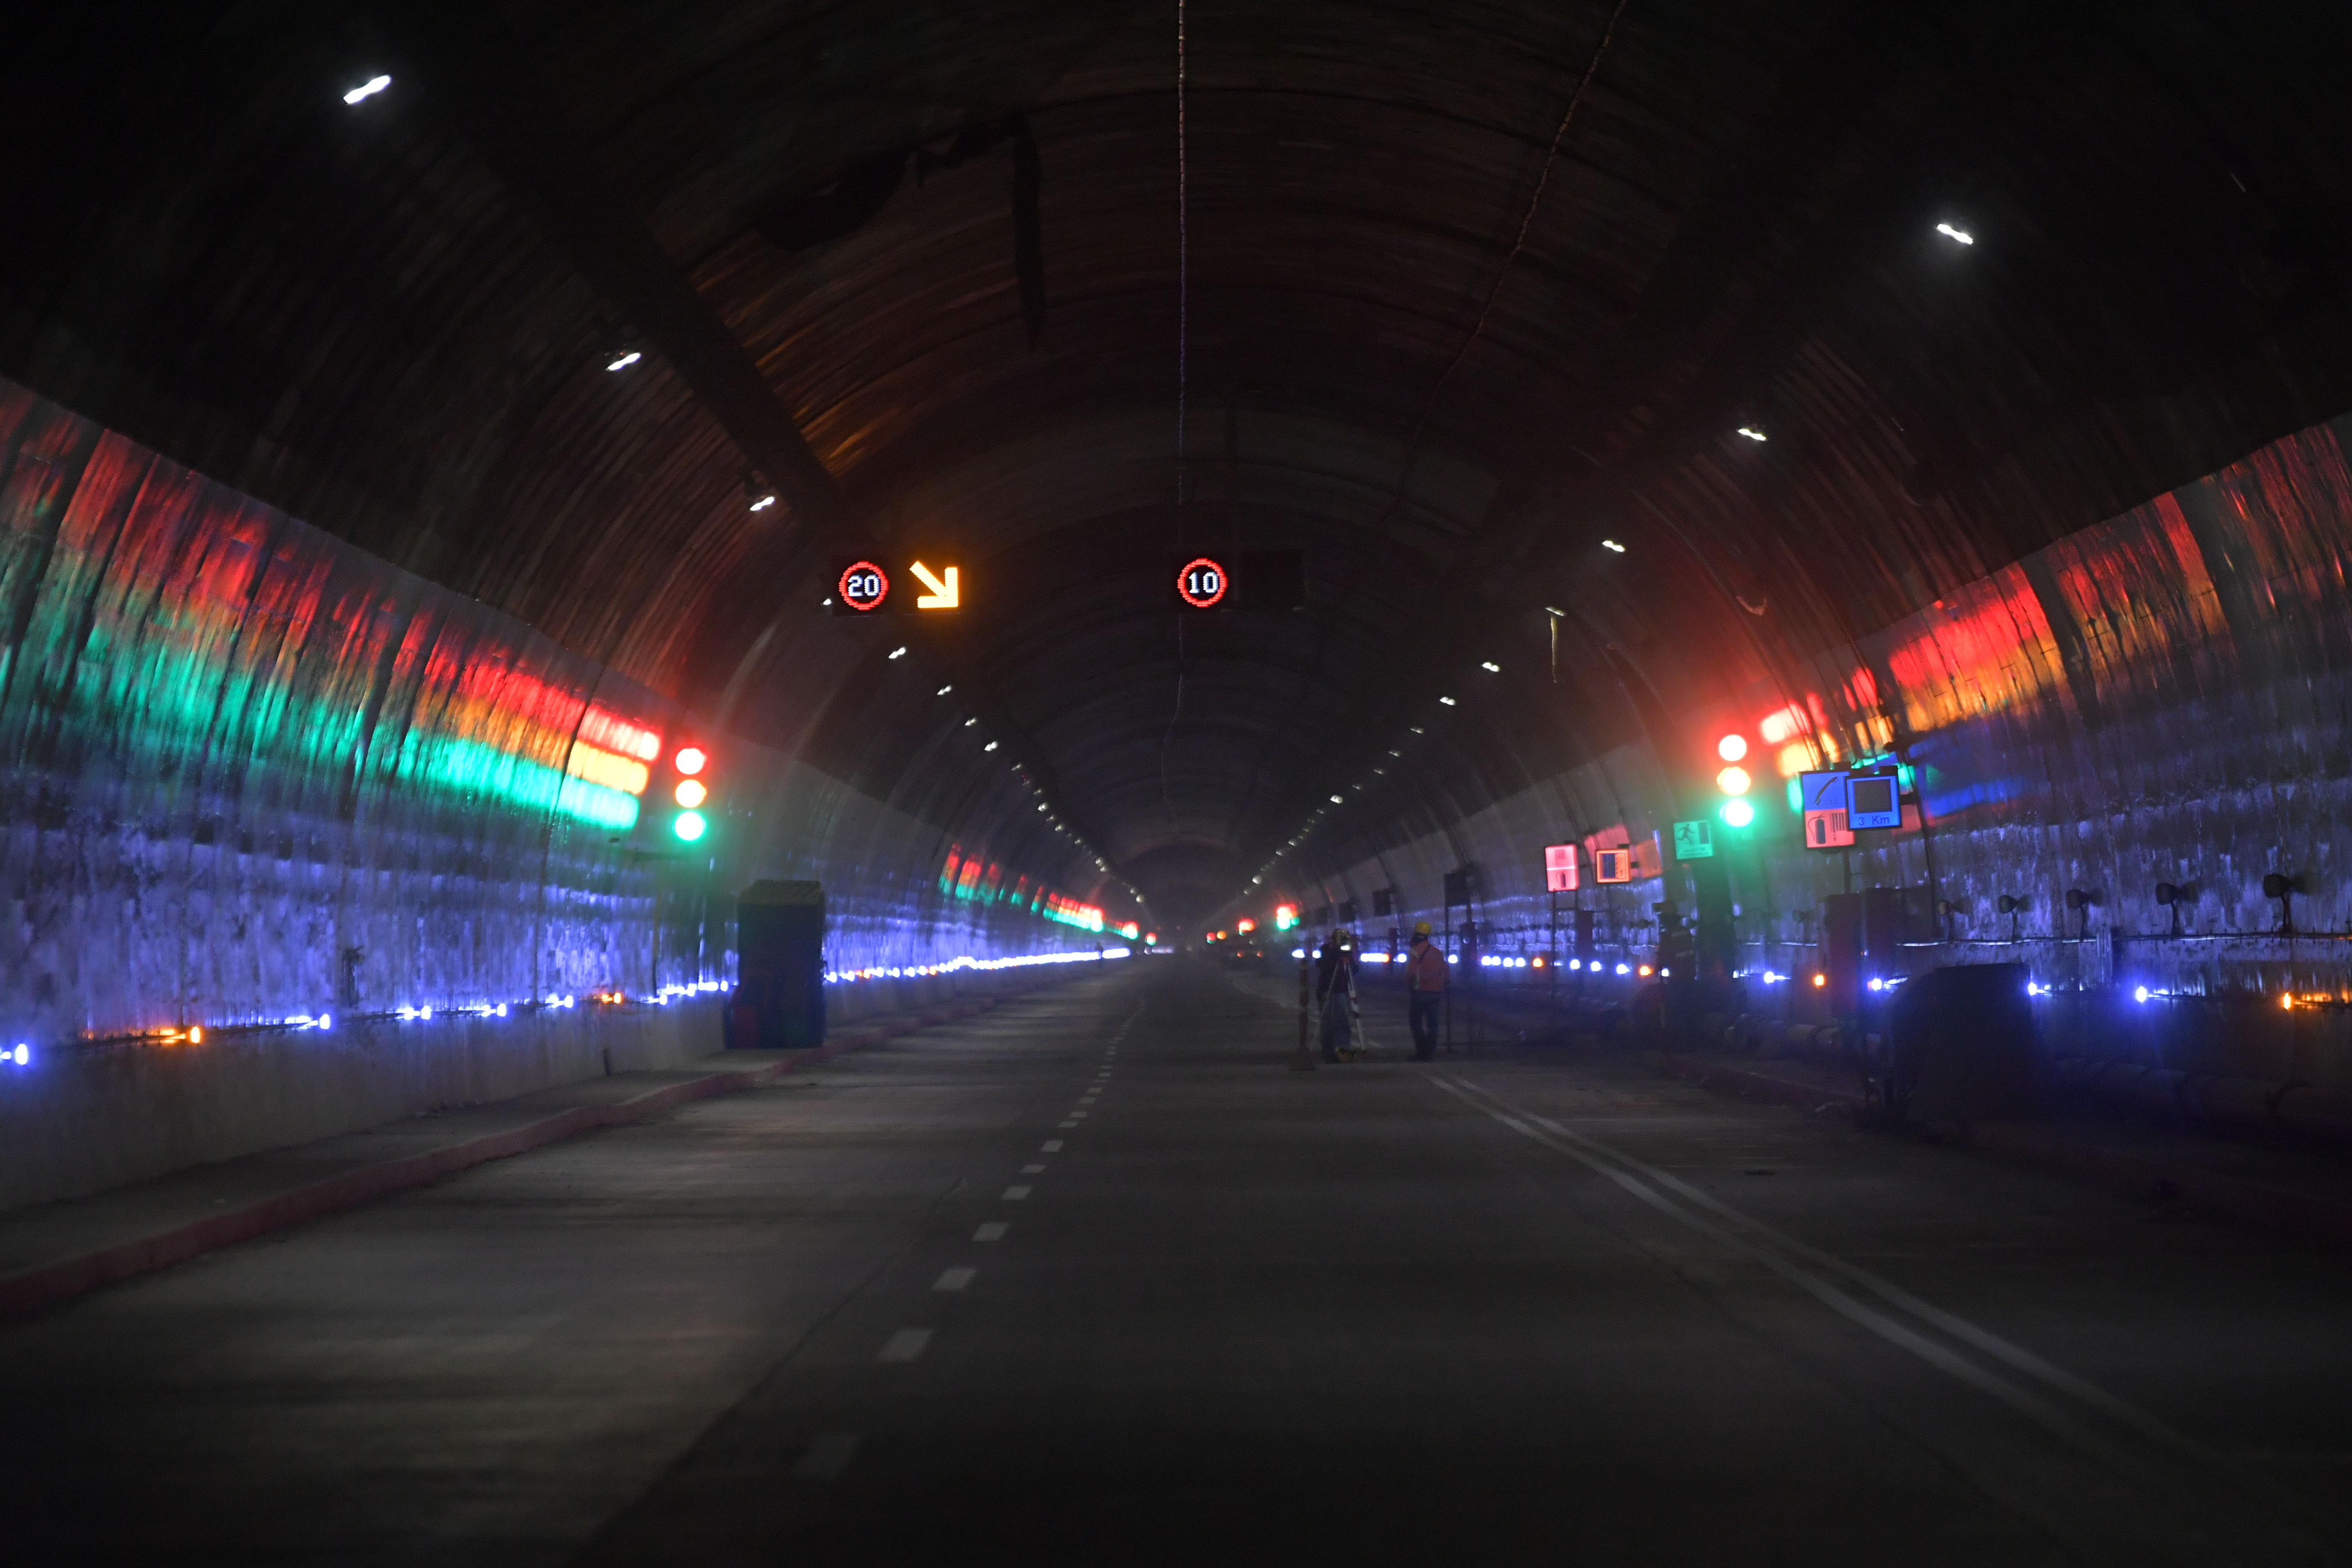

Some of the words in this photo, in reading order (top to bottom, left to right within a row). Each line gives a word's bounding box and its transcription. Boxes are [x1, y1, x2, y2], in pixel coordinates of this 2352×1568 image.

[847, 574, 879, 596] 20
[1189, 572, 1218, 593] 10
[1859, 817, 1864, 825] 3
[1872, 816, 1889, 825] Km
